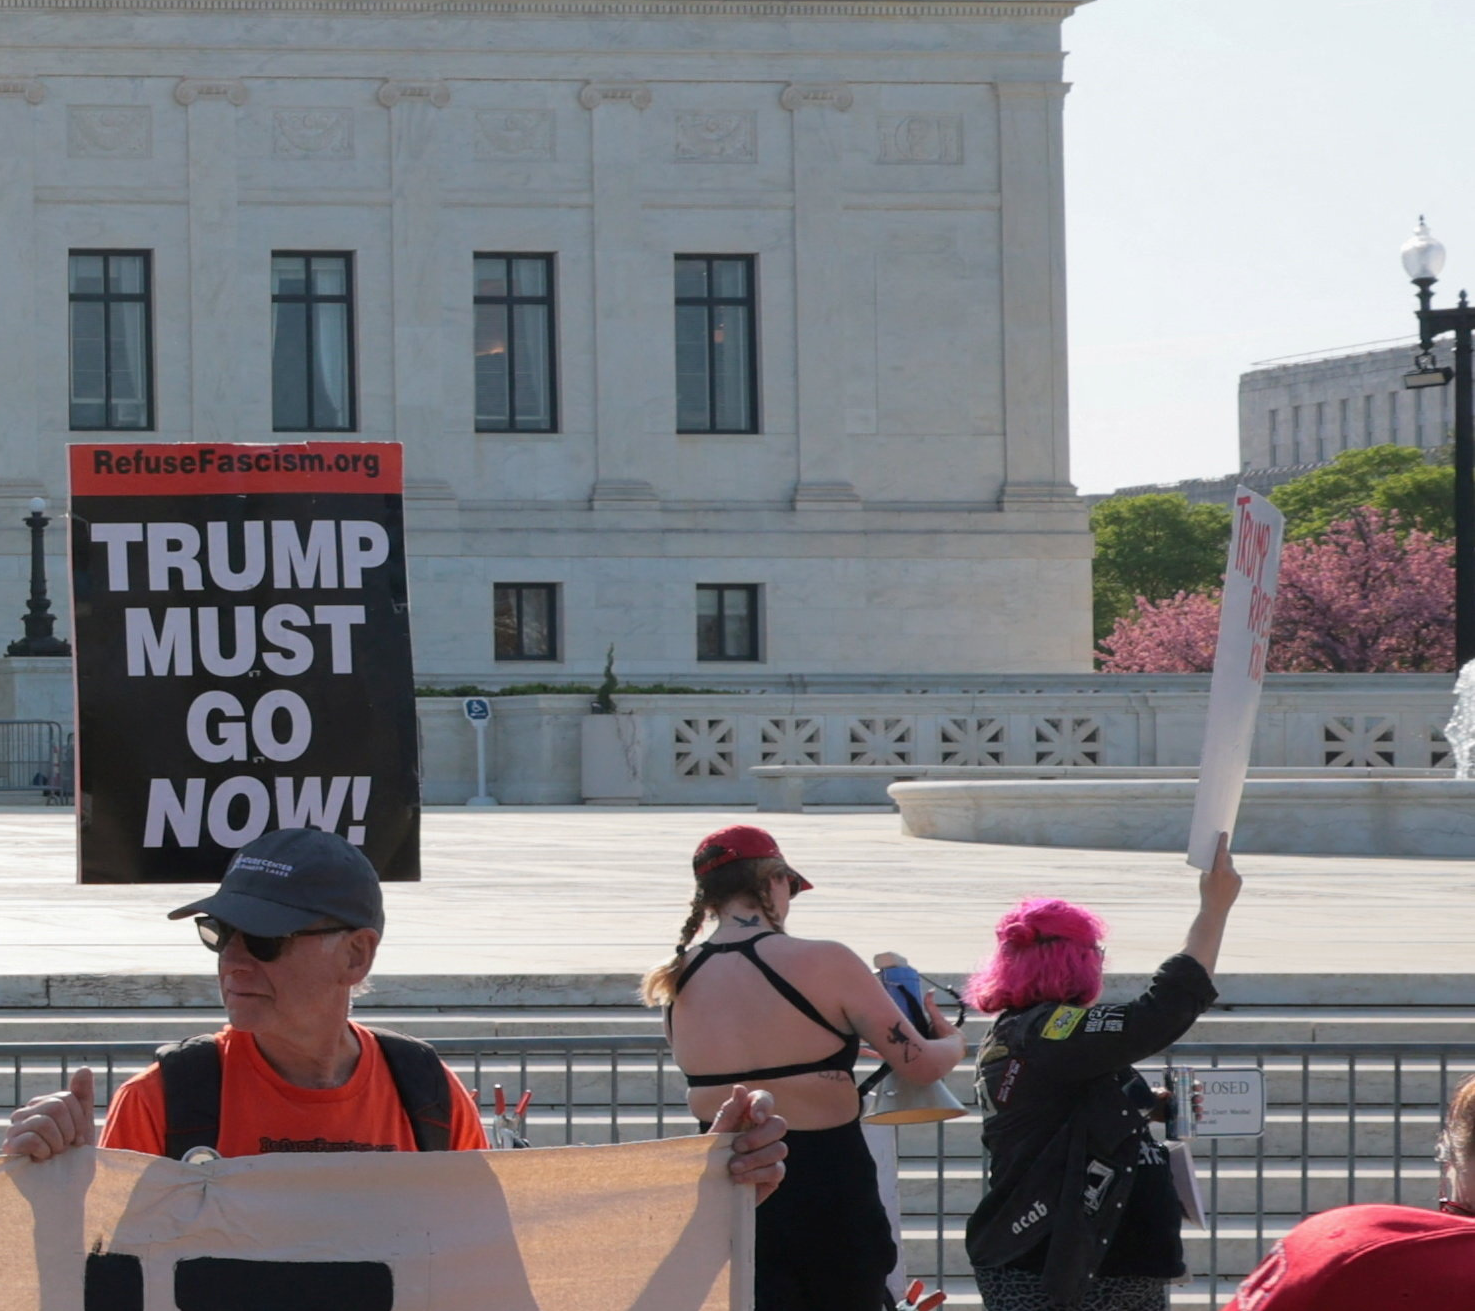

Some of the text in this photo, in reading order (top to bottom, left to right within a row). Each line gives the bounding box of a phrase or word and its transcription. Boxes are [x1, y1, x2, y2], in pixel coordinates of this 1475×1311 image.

[93, 448, 381, 477] RefuseFascism.org
[90, 519, 391, 592] TRUMP
[124, 603, 366, 677] MUST
[186, 689, 313, 764] GO
[143, 774, 372, 849] NOW!
[1204, 1081, 1250, 1095] LOSED
[1011, 1200, 1048, 1234] acab
